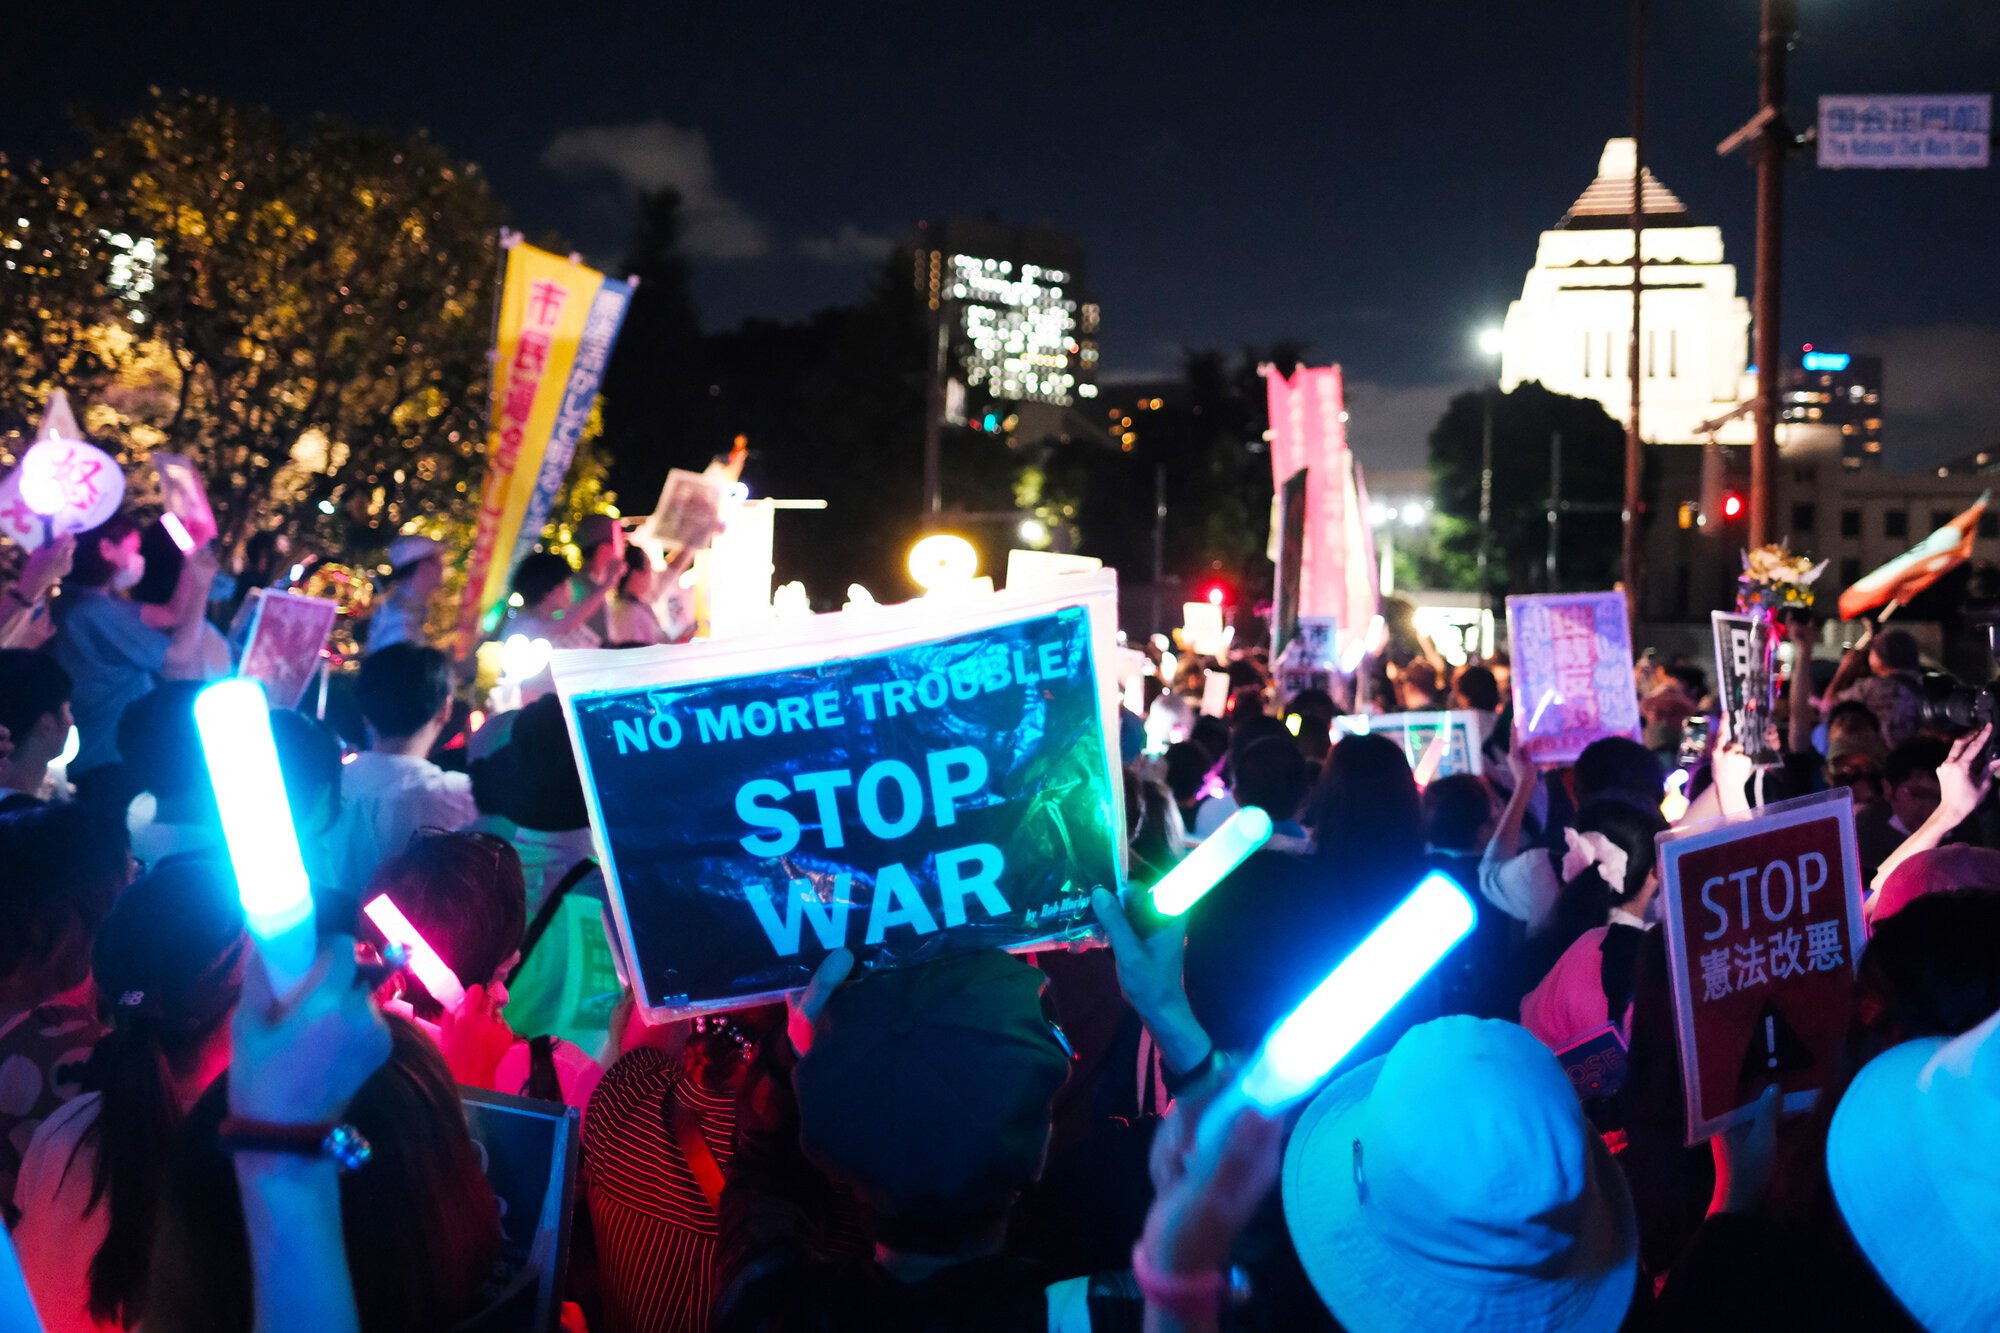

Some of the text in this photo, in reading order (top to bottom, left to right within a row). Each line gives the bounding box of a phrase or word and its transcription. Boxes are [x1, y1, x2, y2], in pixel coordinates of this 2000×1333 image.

[612, 639, 1069, 755] NO MORE TROUBLE
[734, 746, 990, 858] STOP
[746, 842, 1012, 958] WAR
[1700, 850, 1829, 942] STOP
[1699, 918, 1844, 1003] 憲法改悪
